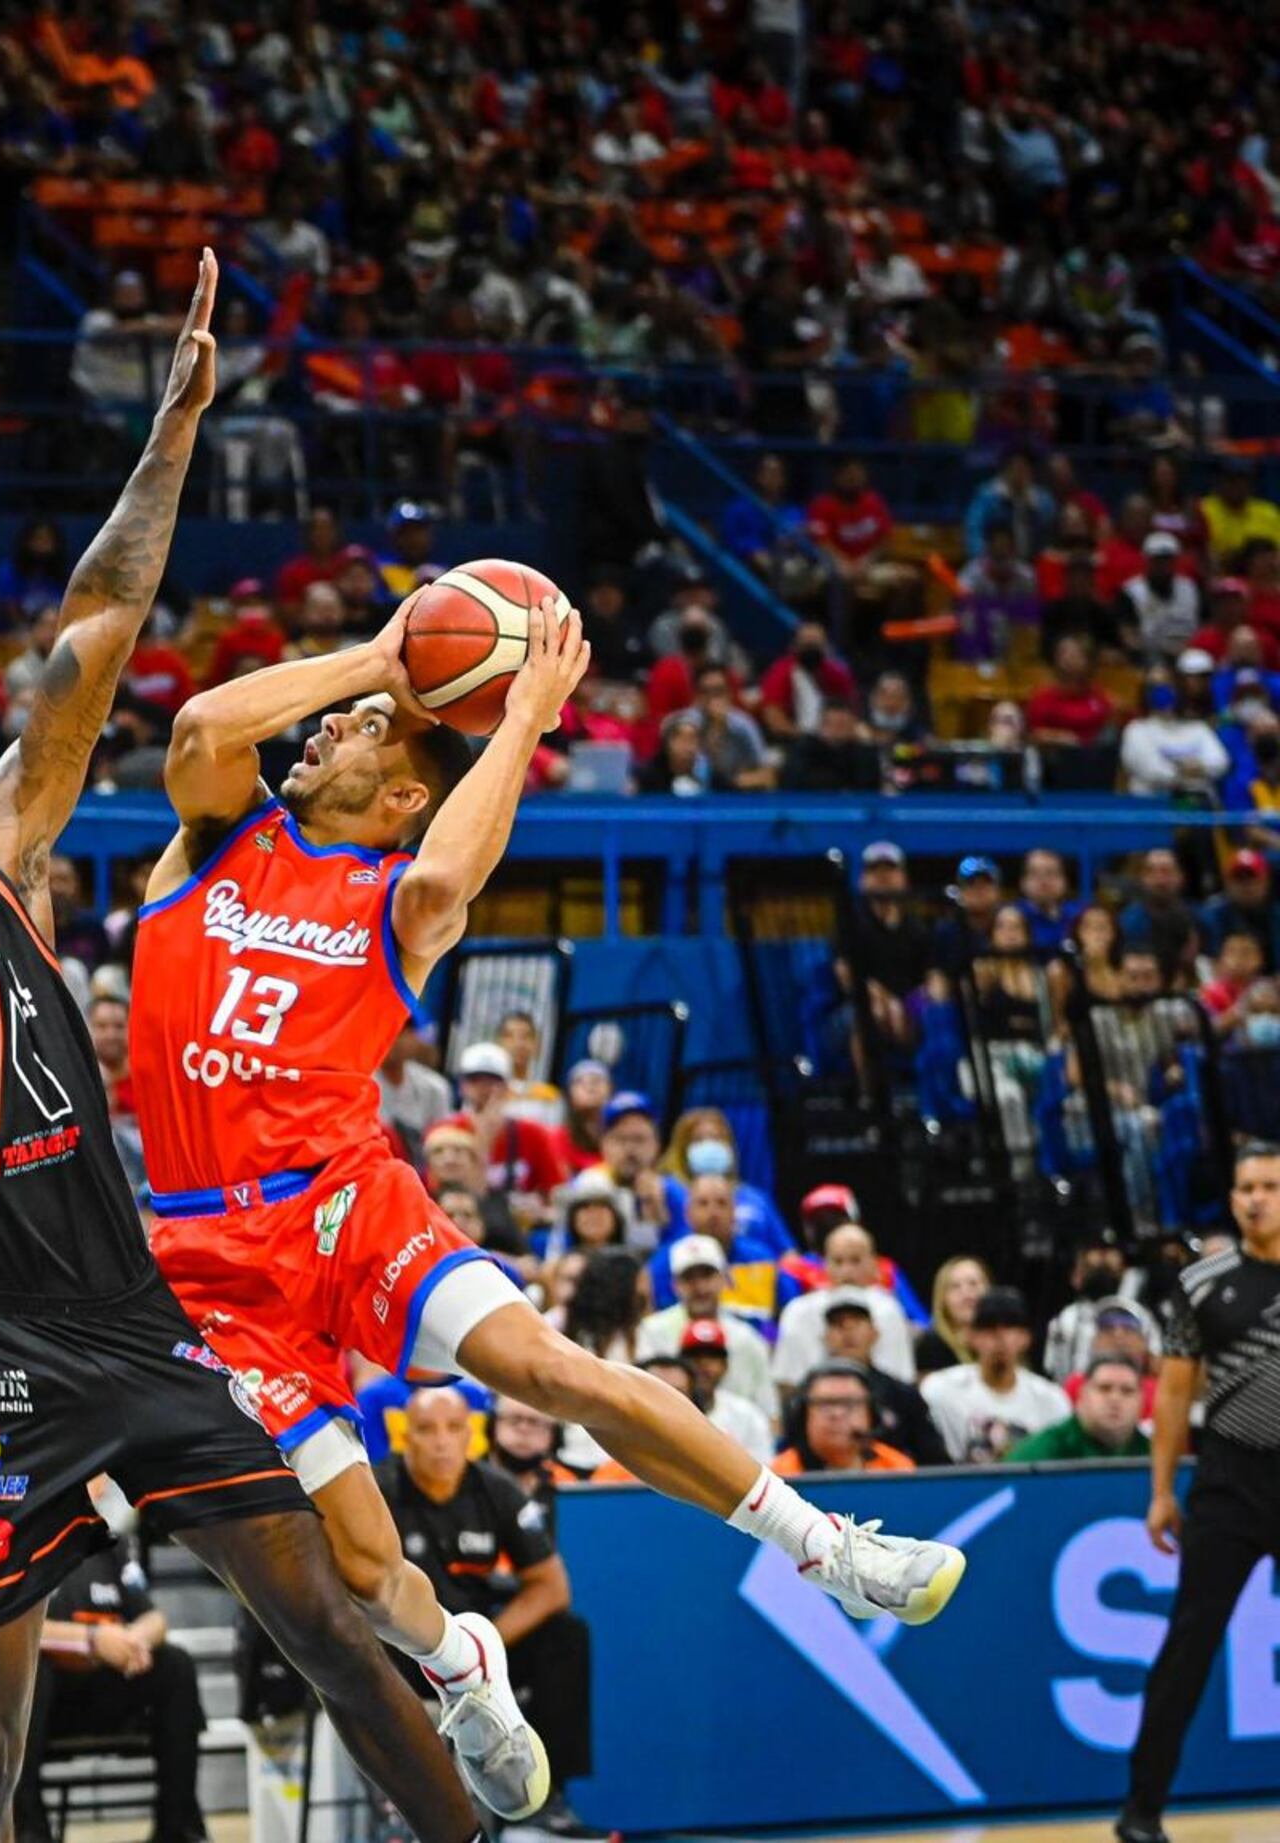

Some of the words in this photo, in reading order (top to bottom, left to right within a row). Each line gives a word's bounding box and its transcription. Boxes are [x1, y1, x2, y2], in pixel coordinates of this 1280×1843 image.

[203, 878, 370, 965] Bayamón
[210, 965, 299, 1046] 13
[379, 1224, 435, 1292] Liberty
